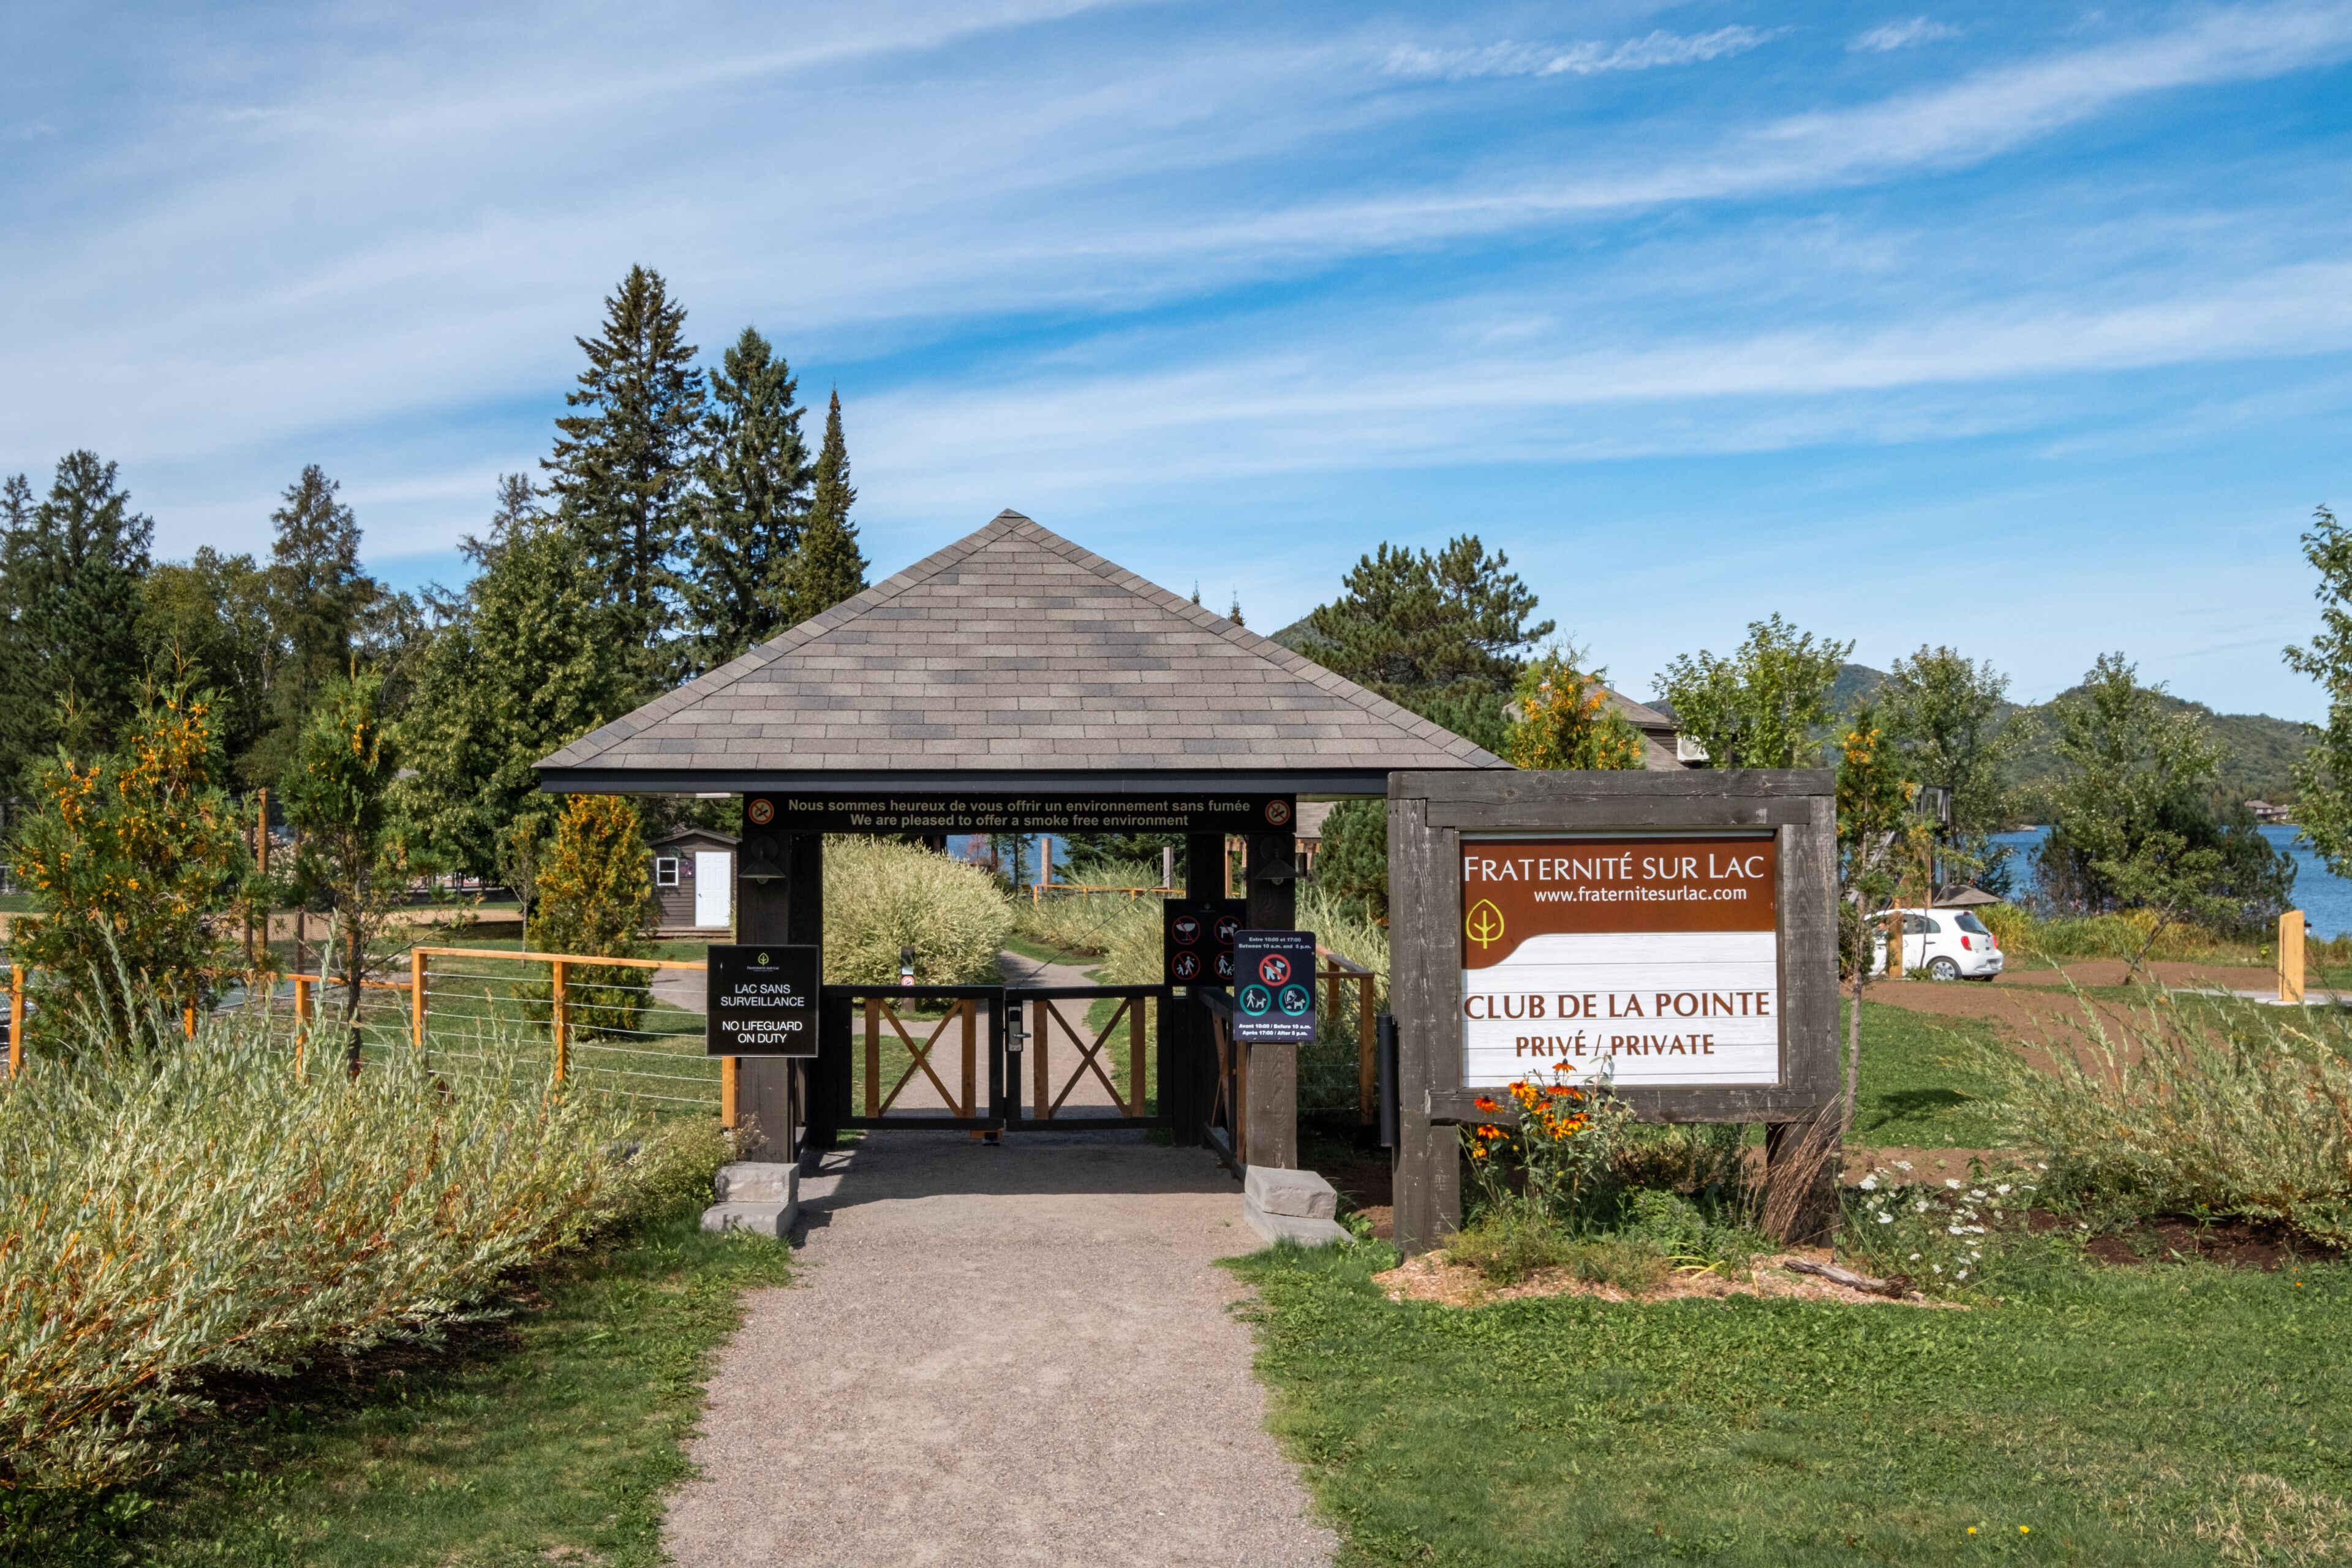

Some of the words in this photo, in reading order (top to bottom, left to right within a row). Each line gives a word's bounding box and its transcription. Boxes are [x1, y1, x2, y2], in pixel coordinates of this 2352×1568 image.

[788, 799, 824, 812] Nous
[827, 802, 886, 812] sommes
[890, 799, 946, 812] heureux
[949, 799, 966, 812] de
[970, 802, 1003, 812] vous
[1007, 799, 1041, 812] offrir
[1045, 802, 1062, 812] un
[1066, 800, 1169, 812] environnement
[1172, 802, 1204, 812] sans
[1208, 799, 1250, 812] fumée
[850, 813, 872, 826] We
[875, 816, 897, 826] are
[901, 814, 954, 828] pleased
[958, 815, 972, 826] to
[976, 814, 1008, 826] offer
[1011, 817, 1019, 826] a
[1023, 814, 1069, 826] smoke
[1072, 814, 1099, 826] free
[1102, 814, 1188, 826] environment
[1464, 852, 1633, 881] FRATERNITÉ
[1643, 857, 1698, 880] SUR
[1709, 853, 1765, 878] LAC
[1534, 886, 1747, 902] www.fraternitesurlac.com
[735, 984, 757, 994] LAC
[760, 984, 791, 994] SANS
[720, 996, 805, 1007] SURVEILLANCE
[1464, 995, 1545, 1019] CLUB
[1558, 993, 1597, 1018] DE
[1608, 993, 1645, 1017] LA
[1656, 992, 1770, 1017] POINTE
[722, 1020, 740, 1031] NO
[742, 1020, 803, 1031] LIFEGUARD
[737, 1033, 755, 1043] ON
[757, 1033, 787, 1044] DUTY
[1515, 1030, 1586, 1057] PRIVÉ
[1594, 1034, 1602, 1056] /
[1610, 1034, 1714, 1055] PRIVATE
